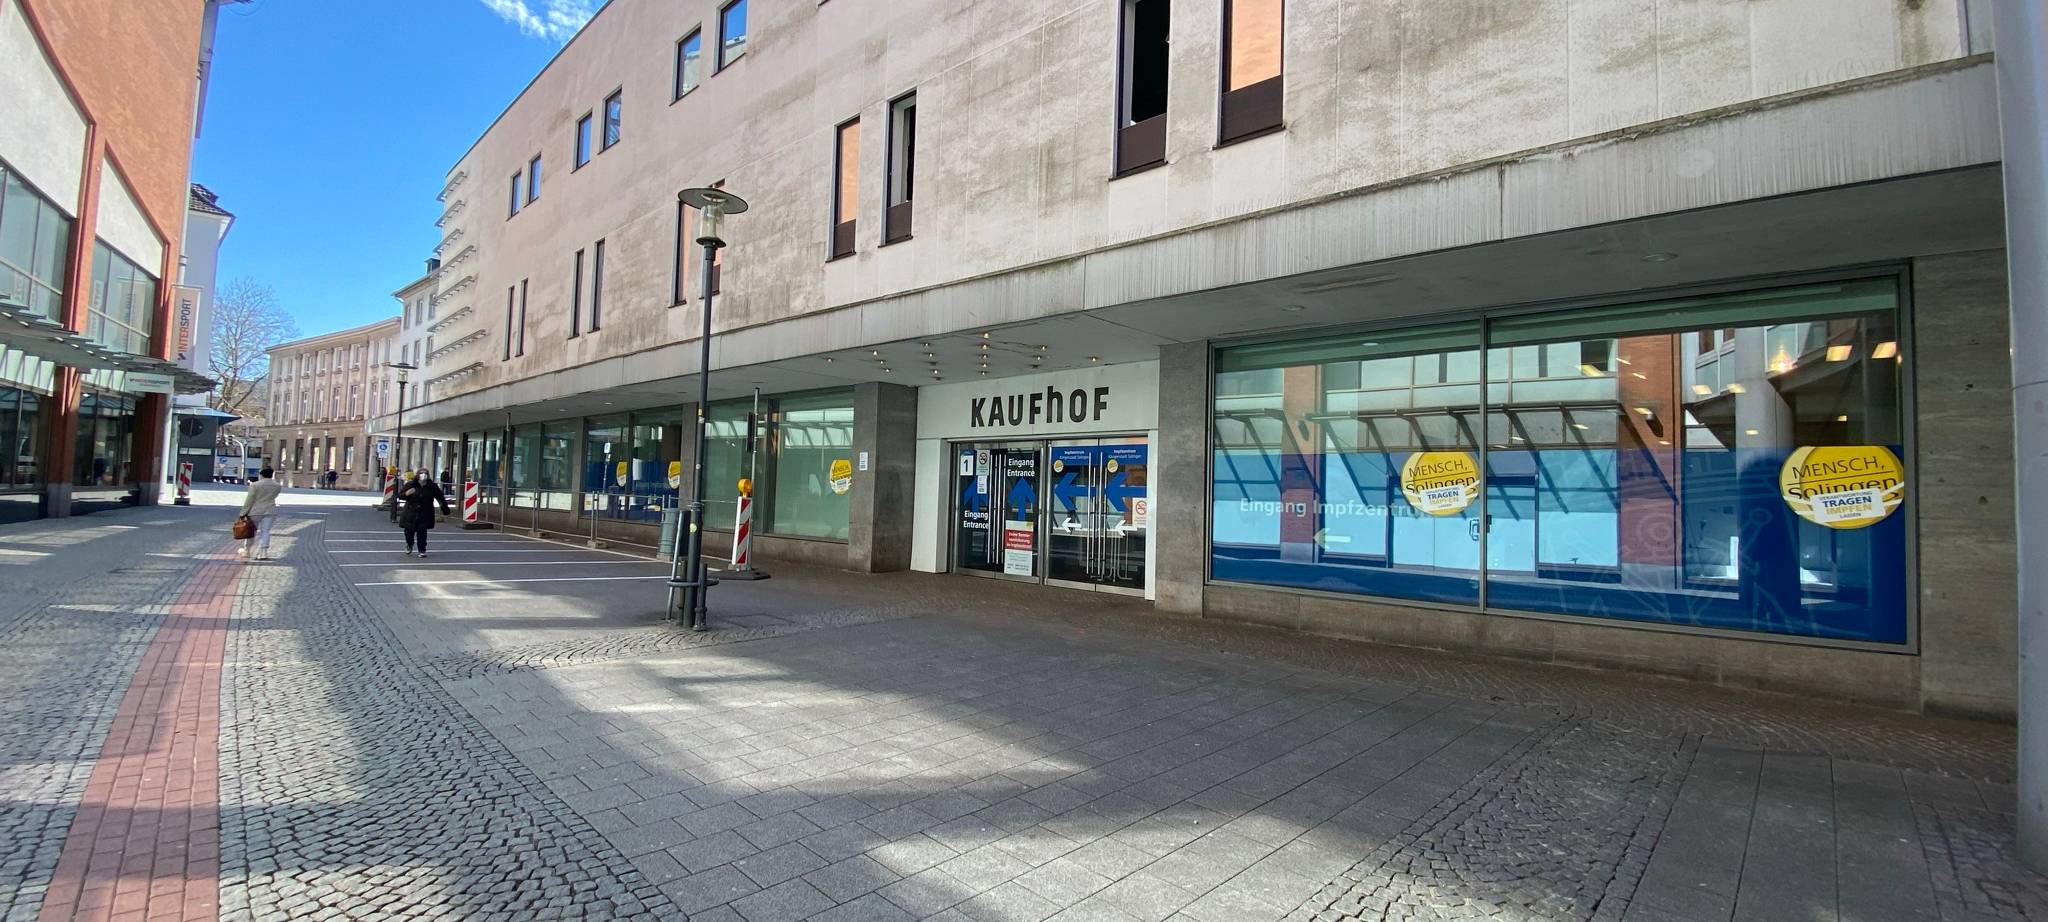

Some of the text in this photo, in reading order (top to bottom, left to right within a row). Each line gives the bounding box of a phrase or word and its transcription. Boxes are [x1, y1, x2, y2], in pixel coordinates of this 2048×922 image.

[178, 298, 192, 352] INTERSPORT
[963, 459, 970, 473] 1
[1008, 458, 1035, 468] Eingang
[1408, 459, 1468, 478] MENSCH,
[1792, 455, 1885, 479] MENSCH,
[1007, 469, 1035, 477] Entrance
[1427, 490, 1459, 500] TRAGEN
[1821, 495, 1872, 508] TRAGEN
[1239, 498, 1429, 518] Eingang Impfzentru
[964, 510, 989, 520] Eingang
[963, 520, 989, 529] Entrance
